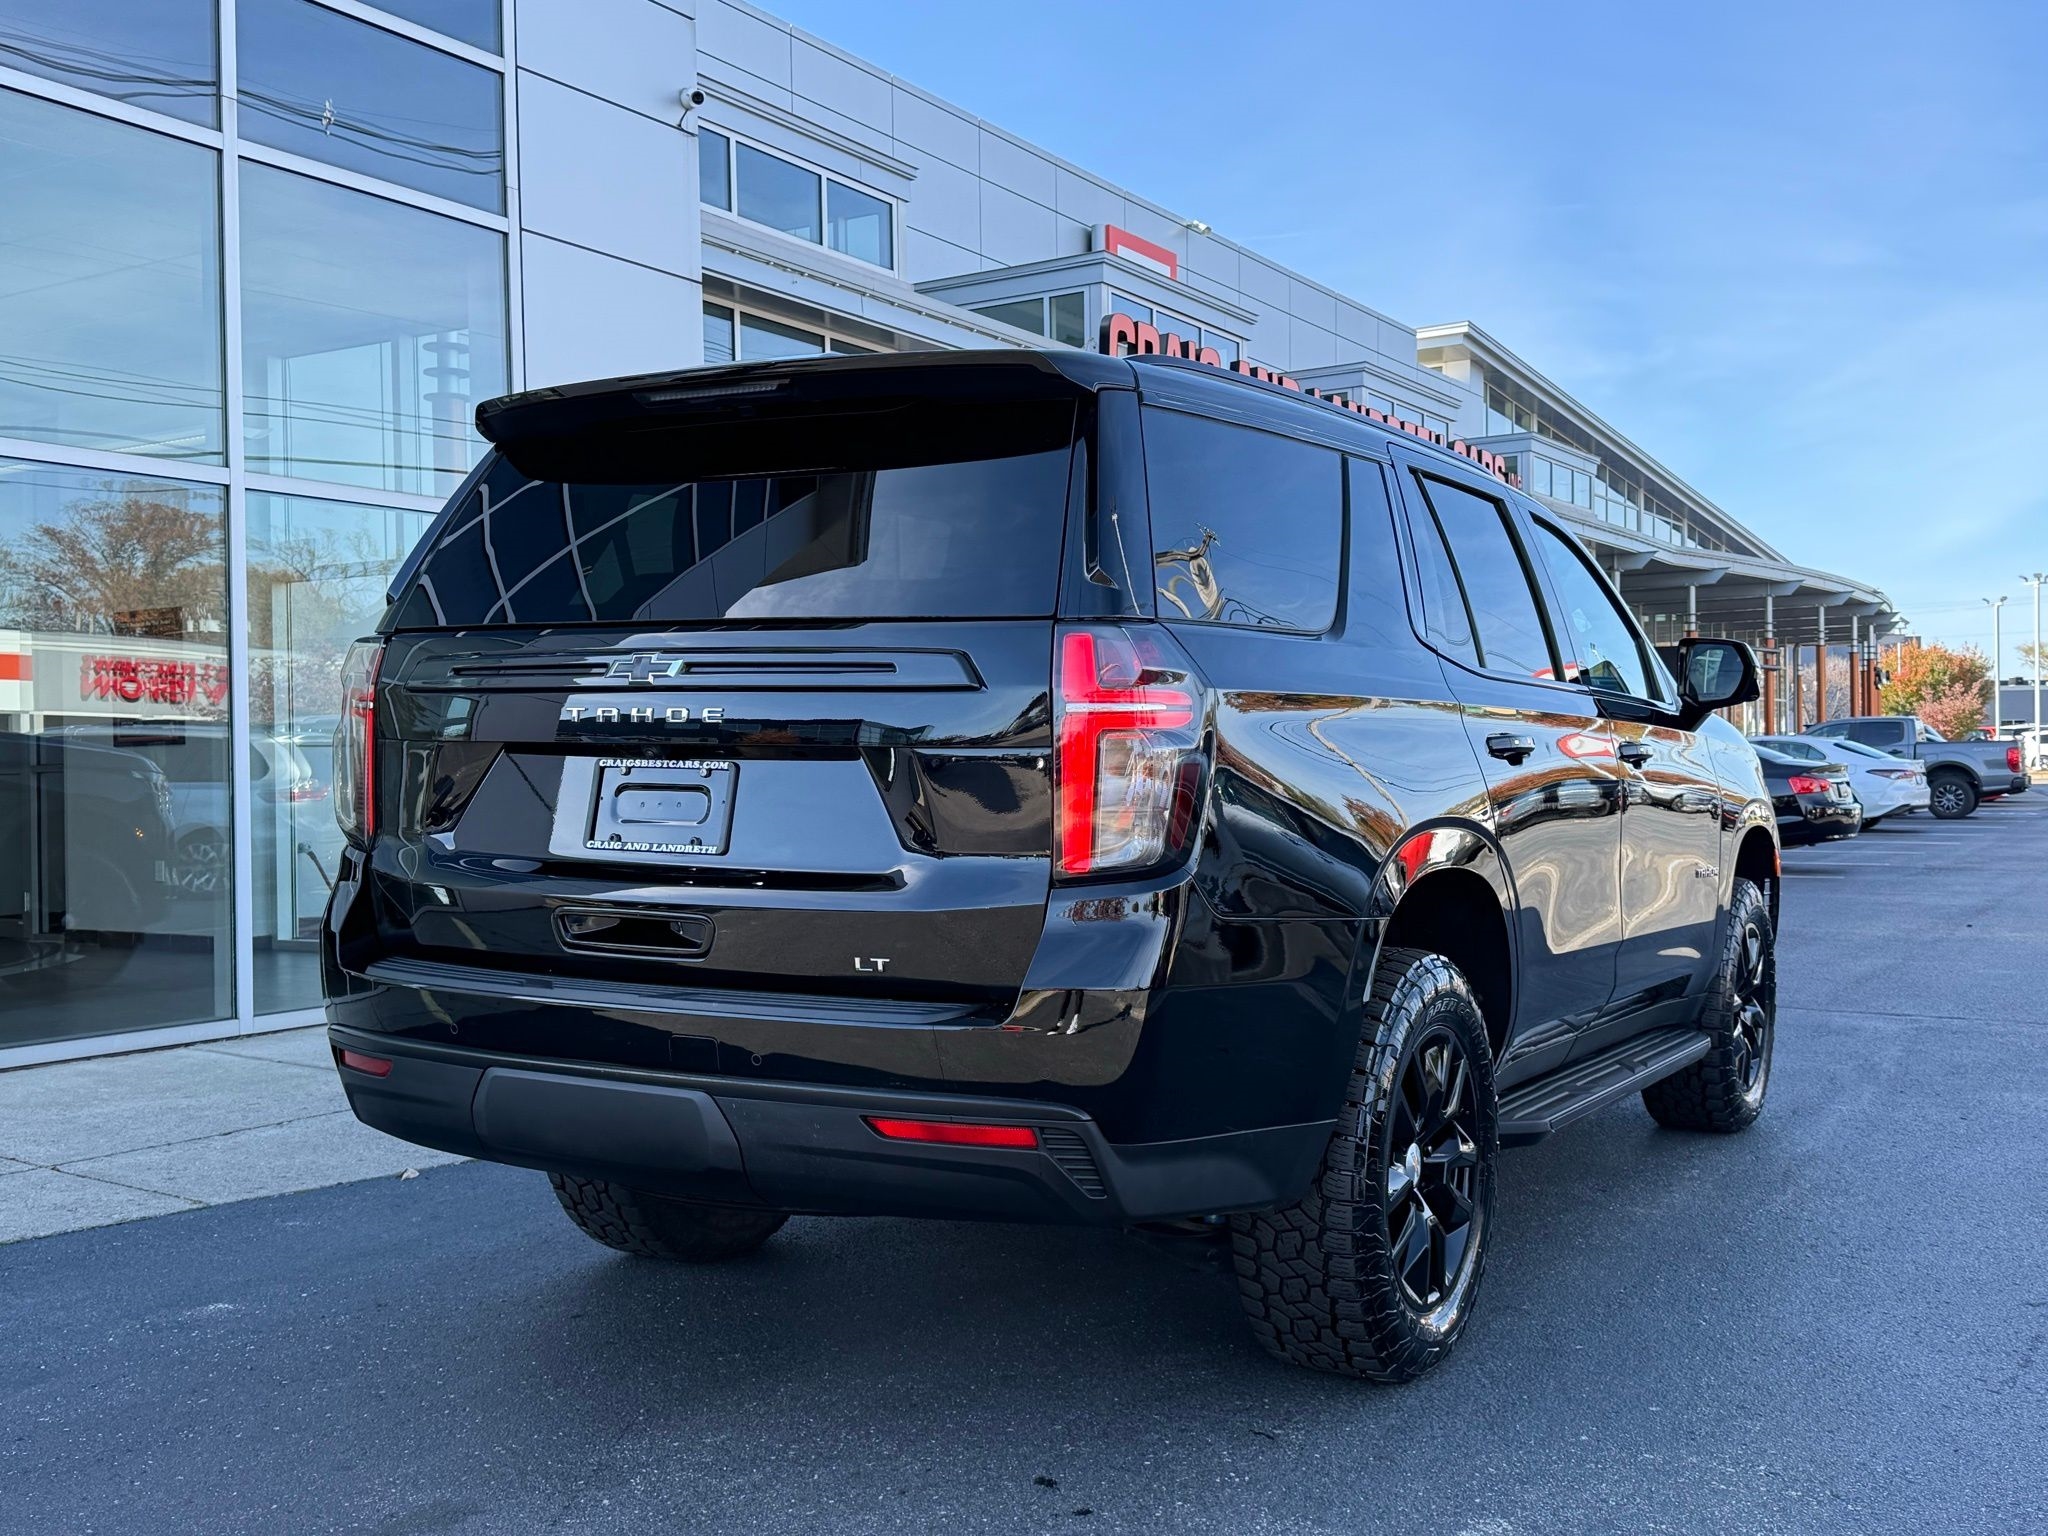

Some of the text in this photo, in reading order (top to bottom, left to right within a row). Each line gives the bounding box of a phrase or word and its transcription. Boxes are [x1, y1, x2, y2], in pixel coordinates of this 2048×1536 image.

[565, 707, 725, 723] TAHOE
[598, 759, 730, 770] CRAIGSBESTCARS.COM
[586, 840, 718, 854] CRAIG AND LANDRETH
[854, 956, 890, 972] LT
